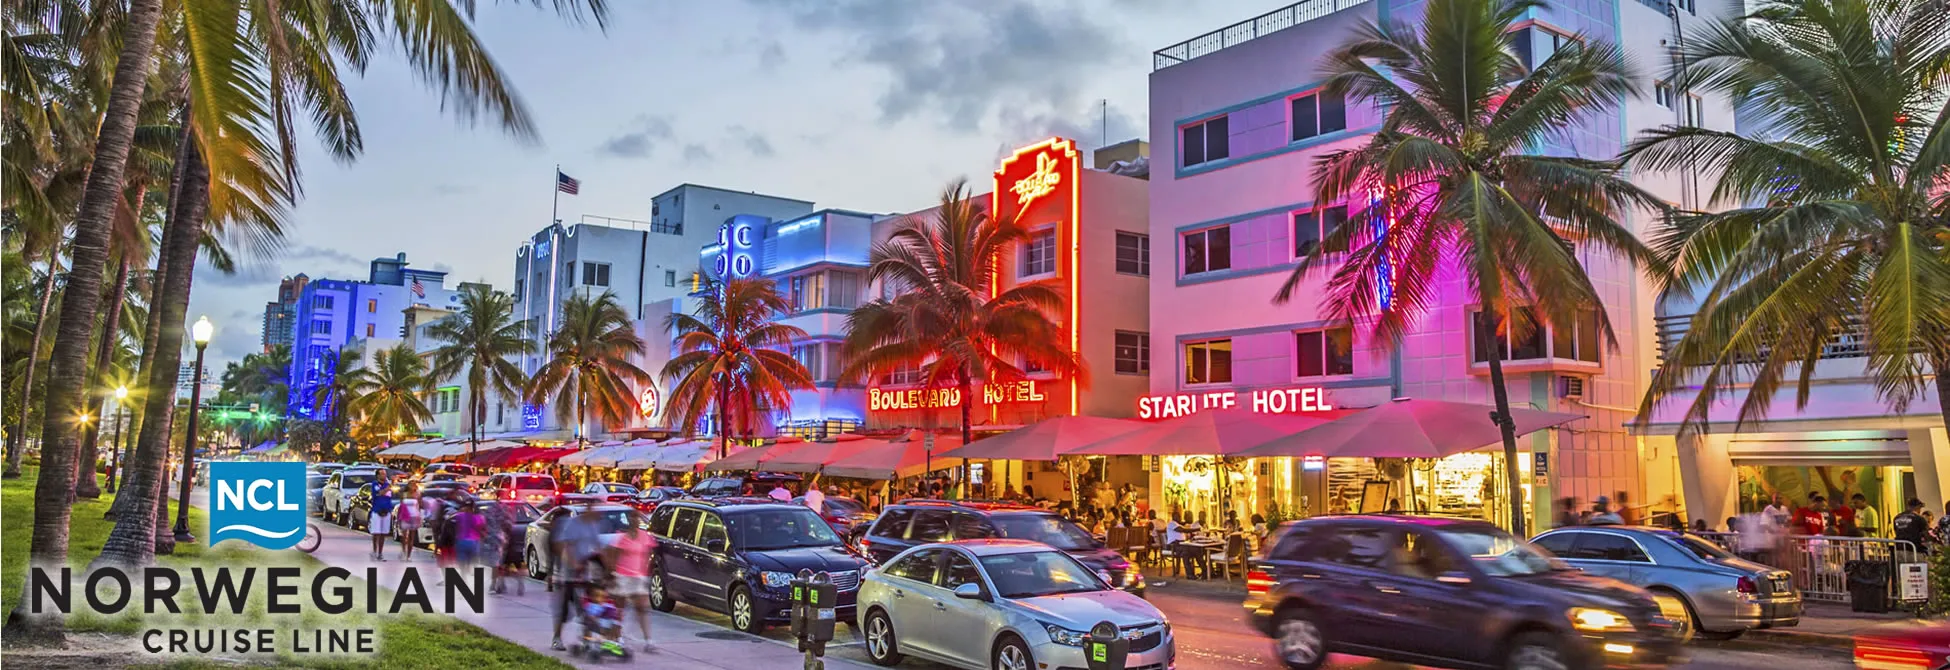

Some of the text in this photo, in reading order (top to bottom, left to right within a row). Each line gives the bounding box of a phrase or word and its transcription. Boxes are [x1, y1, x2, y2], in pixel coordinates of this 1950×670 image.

[870, 380, 1044, 411] BOULEVARD HOTEL
[1253, 387, 1332, 414] HOTEL
